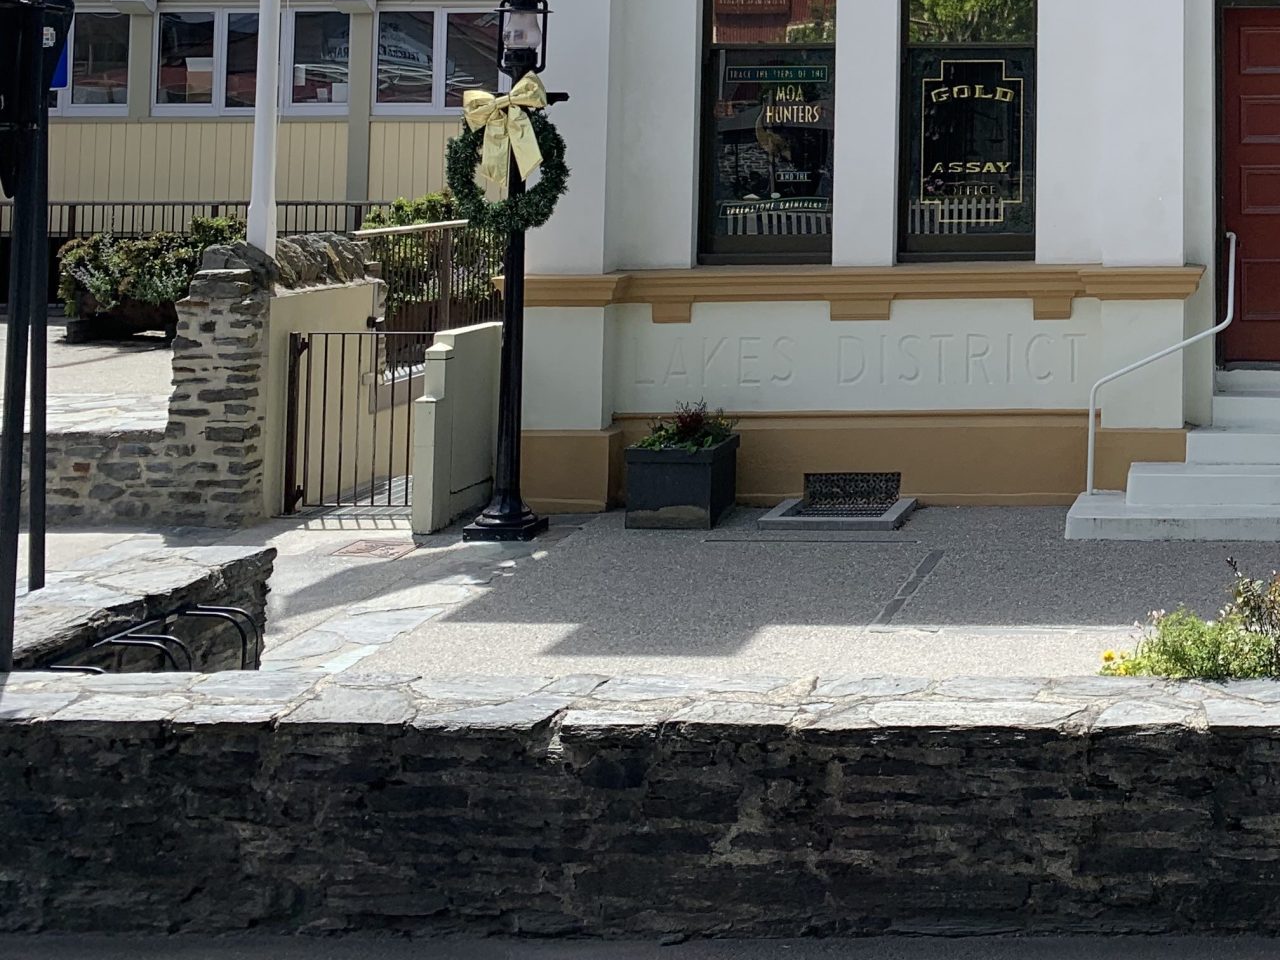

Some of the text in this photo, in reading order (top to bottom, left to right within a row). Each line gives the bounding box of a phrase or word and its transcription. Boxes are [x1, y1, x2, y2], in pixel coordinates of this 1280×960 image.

[775, 84, 805, 102] MOA
[931, 84, 1015, 103] GOLD
[765, 105, 820, 123] HUNTERS
[931, 161, 1012, 174] ASSAY
[632, 332, 1088, 388] LAKES DISTRICT
